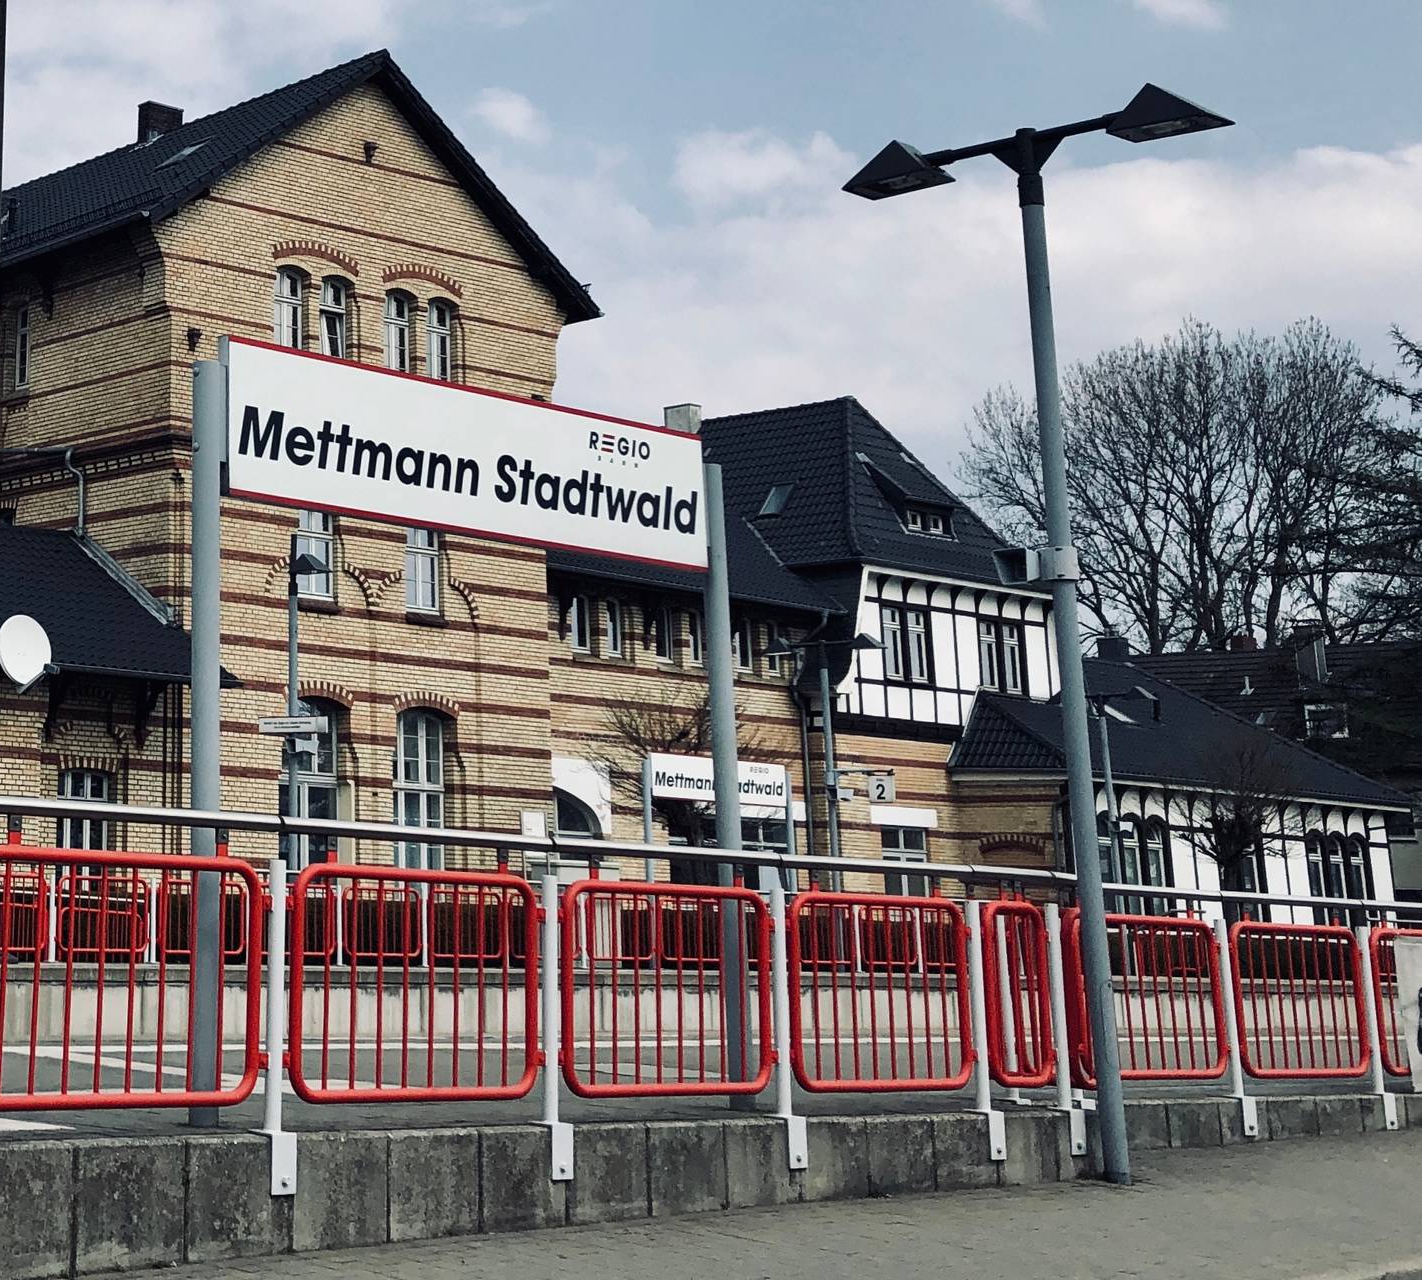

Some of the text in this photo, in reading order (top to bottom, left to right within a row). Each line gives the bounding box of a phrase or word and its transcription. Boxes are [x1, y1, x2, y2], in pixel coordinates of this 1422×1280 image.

[589, 431, 650, 460] REGIO
[238, 405, 698, 535] Mettmann Stadtwald
[876, 783, 886, 800] 2
